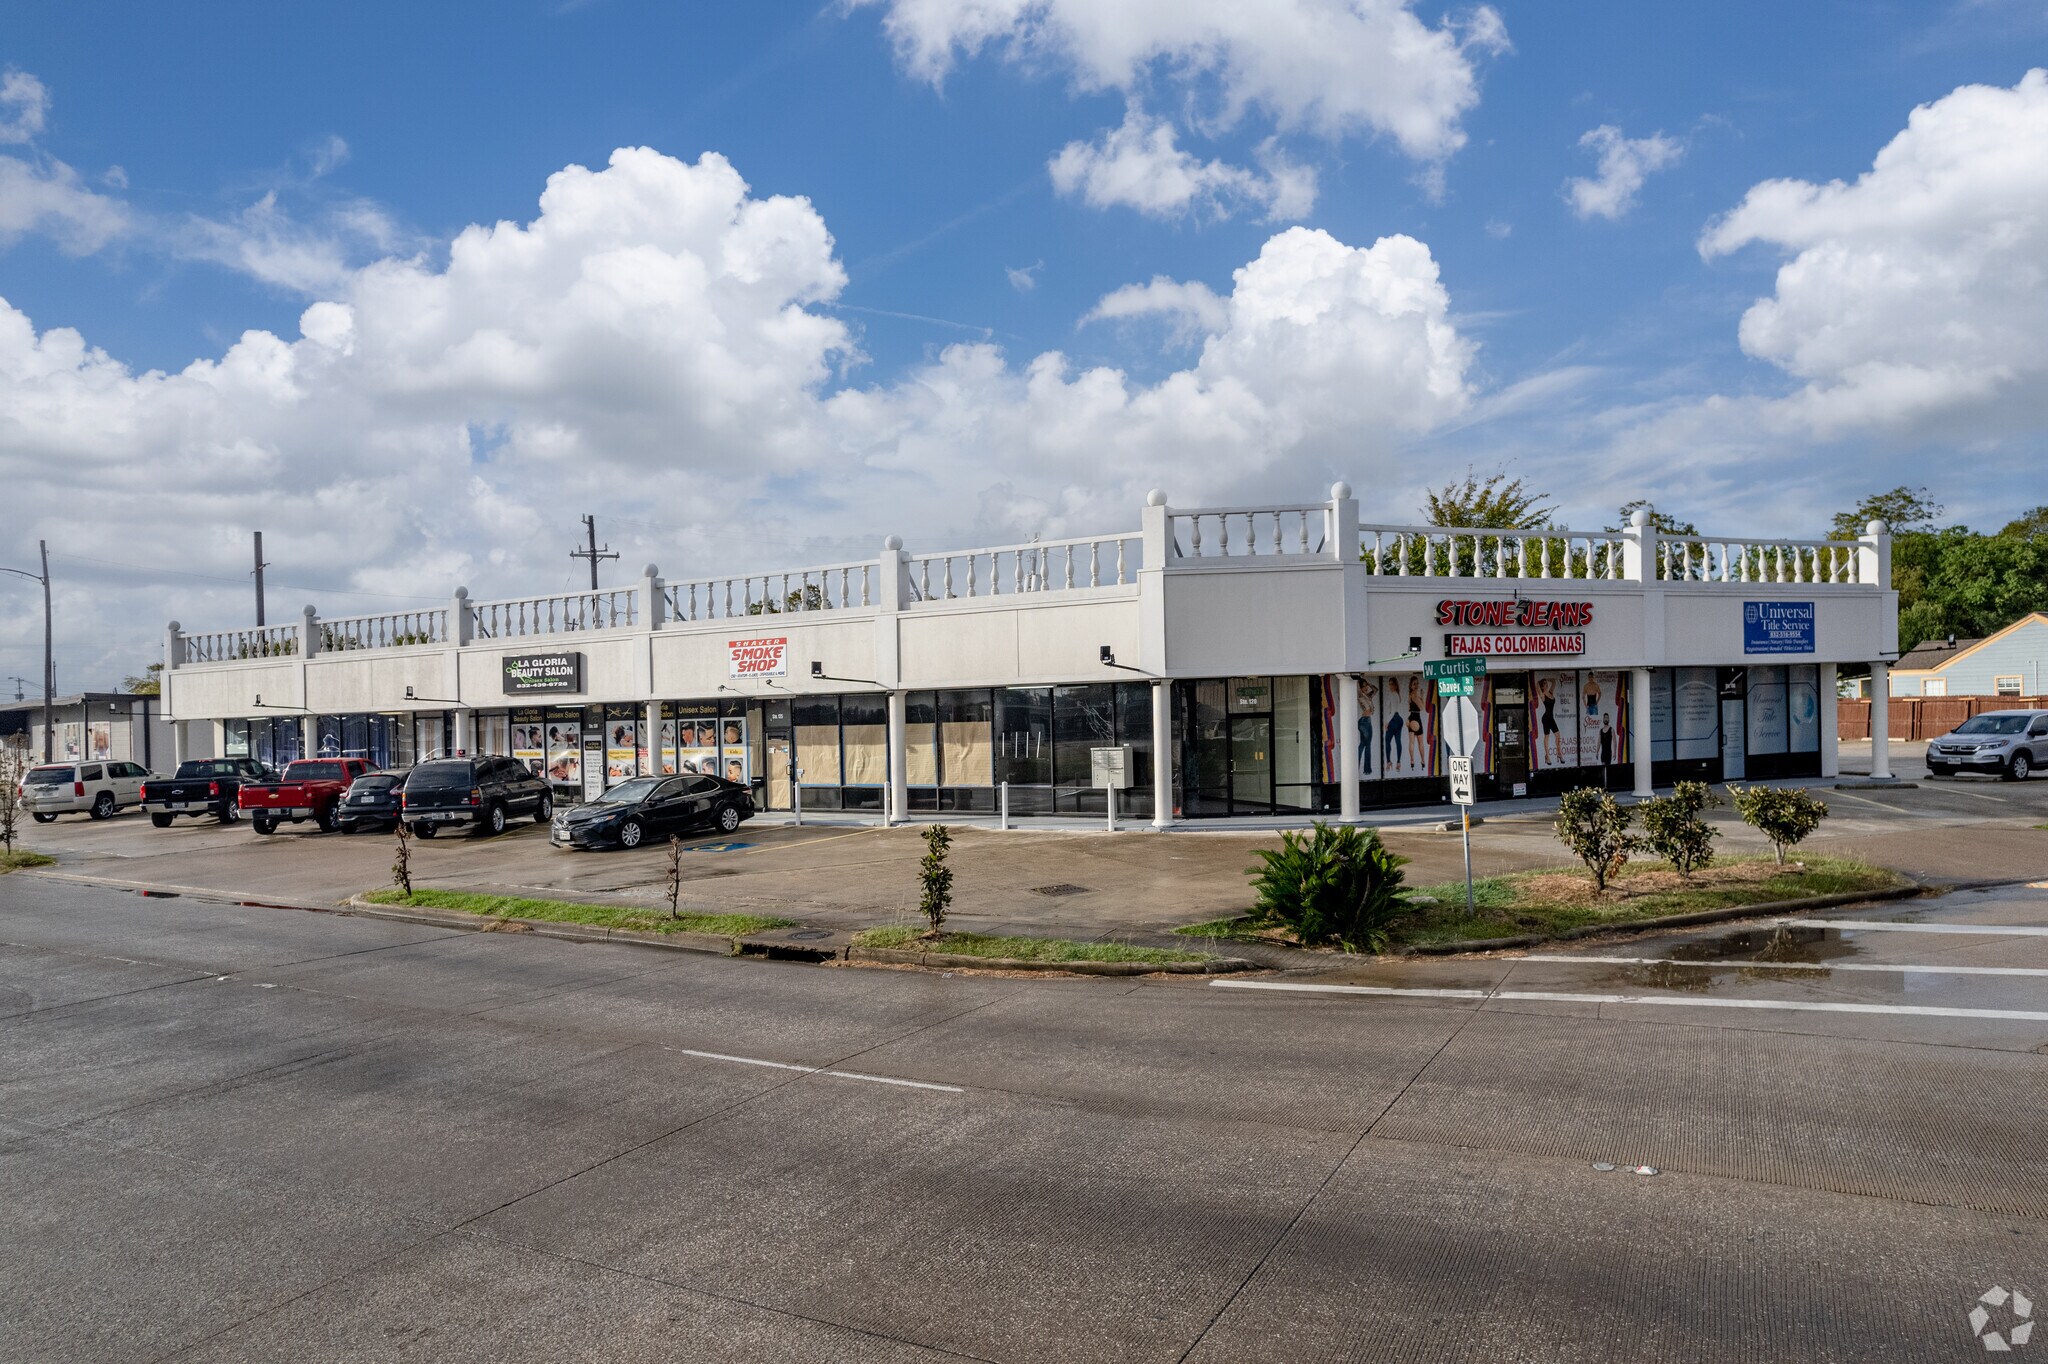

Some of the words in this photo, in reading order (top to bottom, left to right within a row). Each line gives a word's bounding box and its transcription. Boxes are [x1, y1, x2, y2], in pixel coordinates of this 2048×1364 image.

[1438, 600, 1516, 626] STONE
[1521, 601, 1594, 630] JEANS
[1758, 603, 1812, 618] Universal
[1761, 620, 1780, 630] Title
[1782, 620, 1810, 630] Service
[736, 639, 780, 647] SHAVER
[1452, 636, 1490, 653] FAJAS
[1494, 636, 1582, 653] COLOMBIANAS
[732, 646, 784, 661] SMOKE
[532, 658, 567, 667] GLORIA
[737, 659, 778, 673] SHOP
[1425, 665, 1436, 676] W.
[1440, 661, 1470, 675] Curtis
[511, 668, 543, 678] BEAUTY
[545, 666, 573, 676] SALON
[1439, 681, 1460, 693] Shaver
[700, 705, 717, 713] Salon
[1452, 761, 1468, 772] ONE
[1452, 774, 1468, 785] WAY
